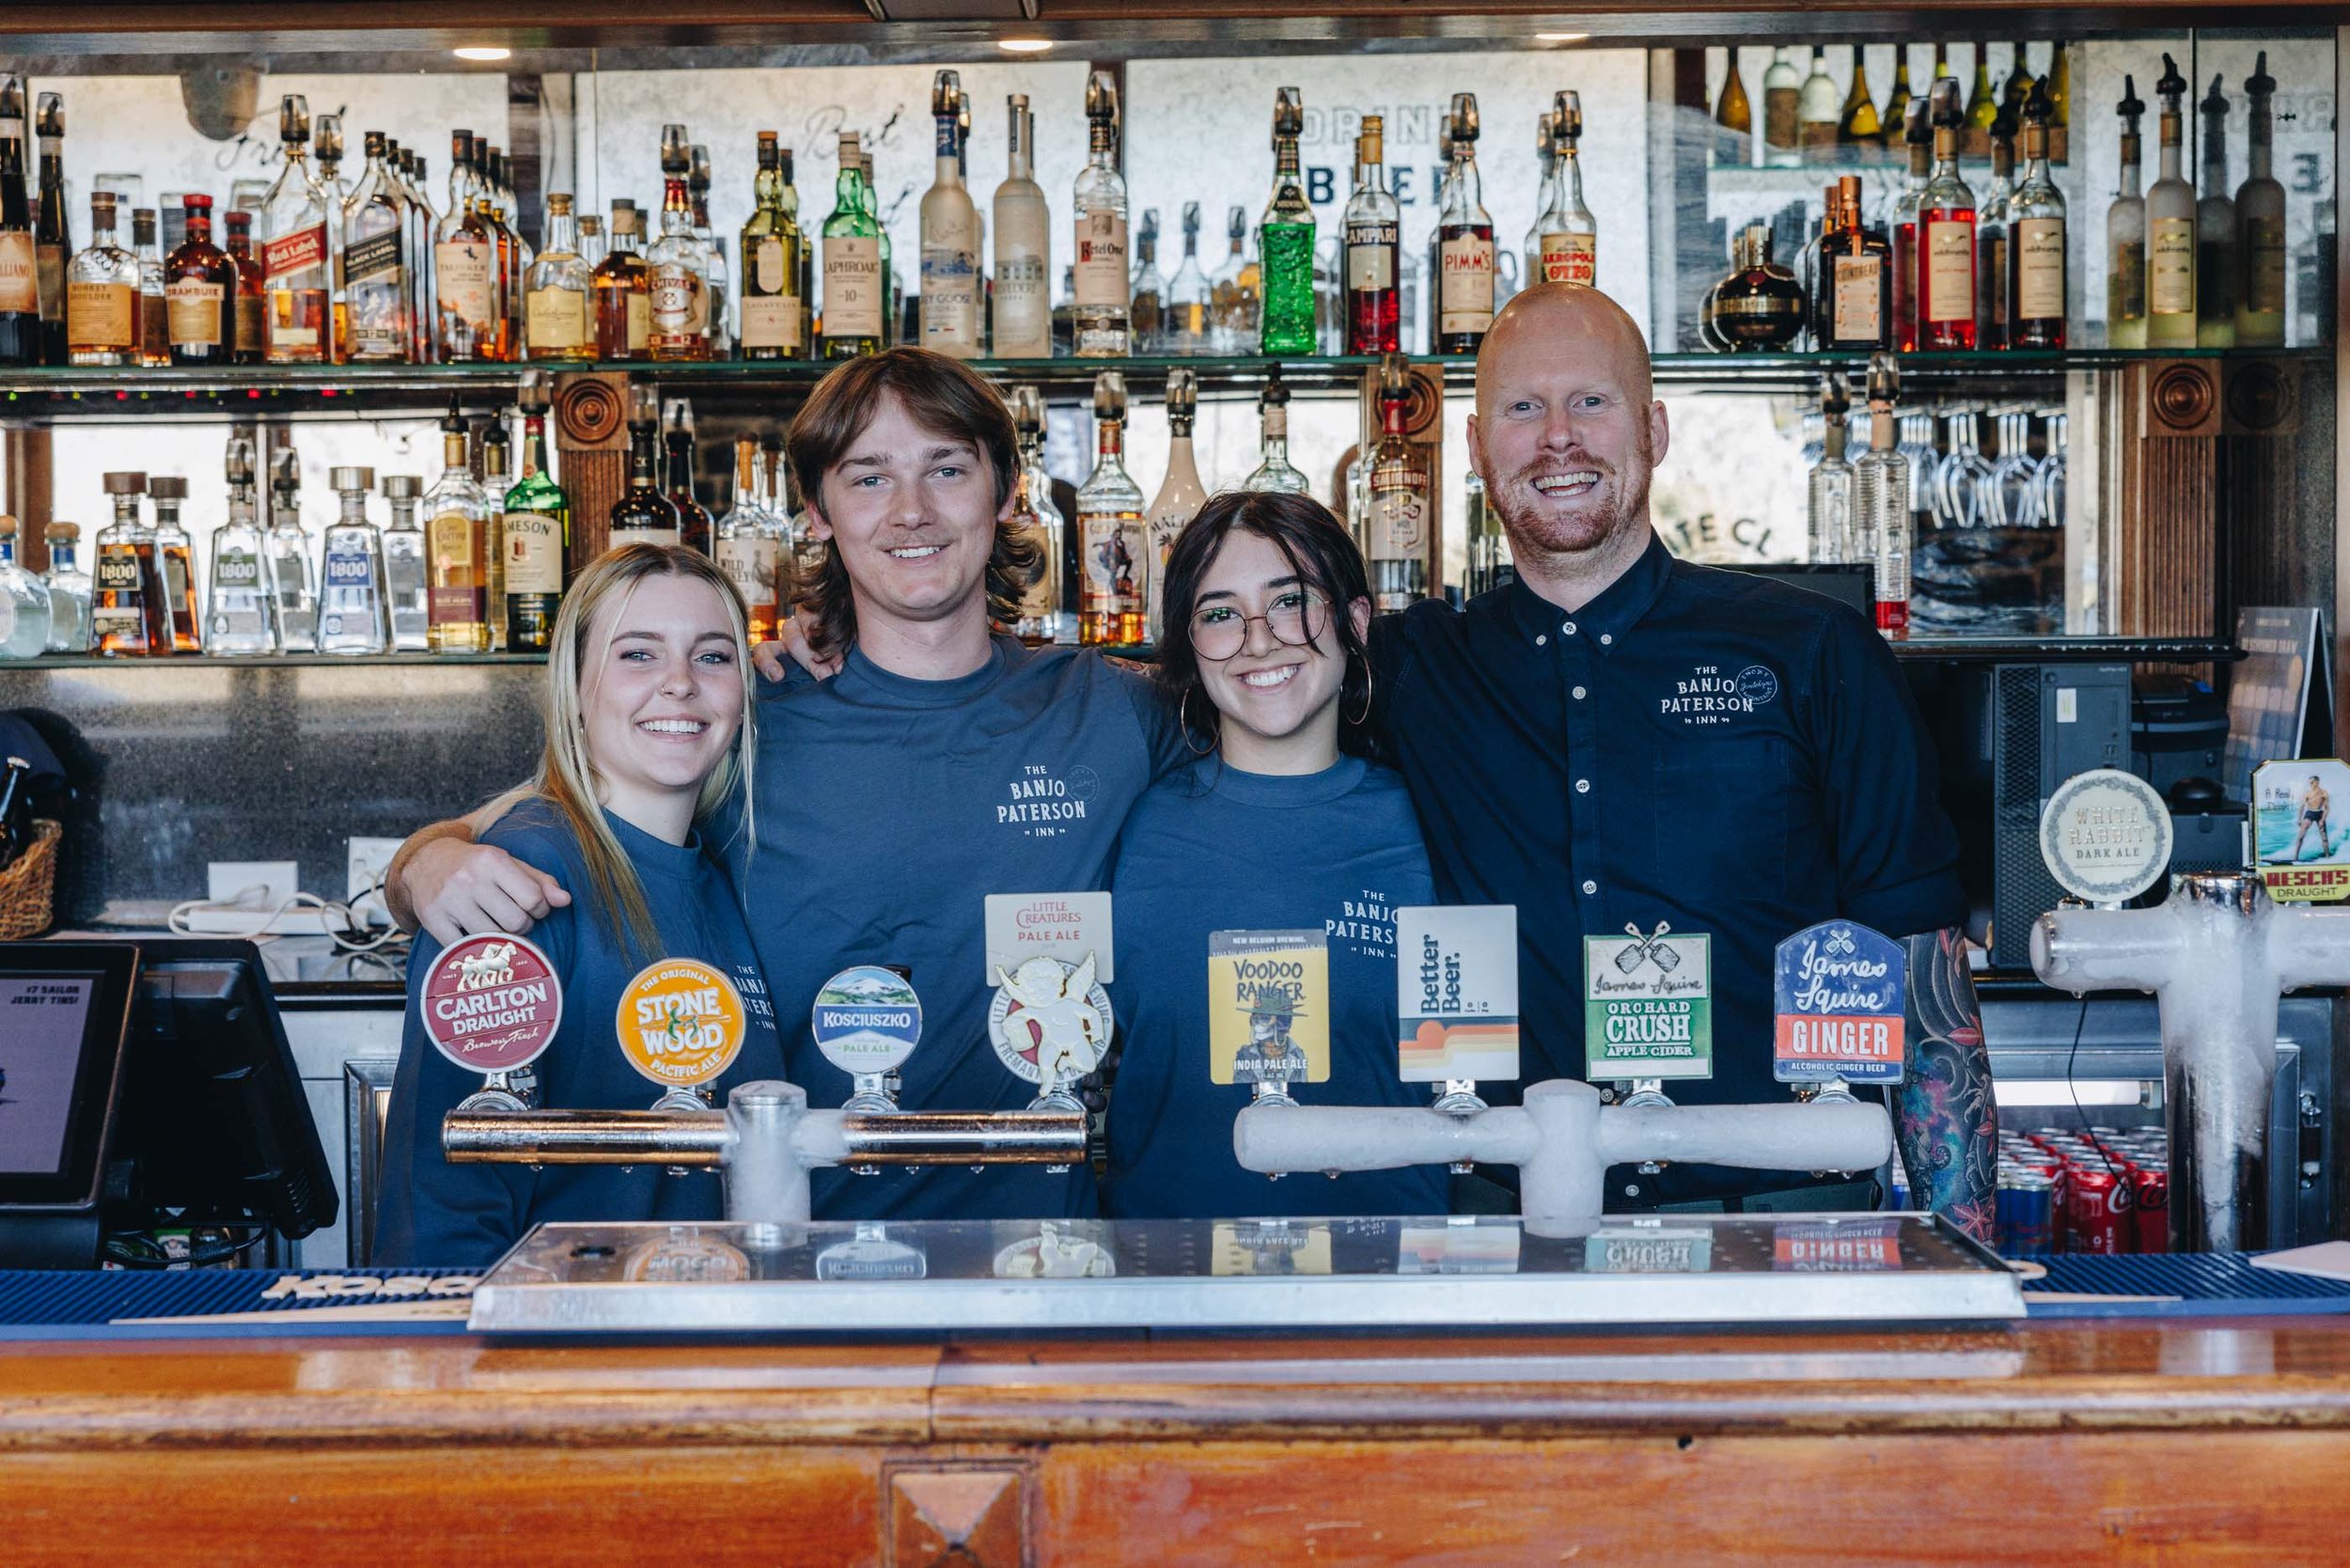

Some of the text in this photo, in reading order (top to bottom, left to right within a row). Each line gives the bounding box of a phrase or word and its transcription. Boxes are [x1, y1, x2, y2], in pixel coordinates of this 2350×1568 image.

[1444, 250, 1491, 272] PIMM'S
[651, 277, 691, 290] CHIVAS
[845, 289, 857, 303] 10
[1372, 472, 1428, 488] SMIRNOFF
[101, 564, 136, 580] 1800
[218, 562, 256, 578] 1800
[330, 561, 367, 578] 1800
[1695, 666, 1717, 675] THE
[1677, 678, 1735, 694] BANJO
[1661, 697, 1754, 713] PATERSON
[1025, 765, 1047, 775] THE
[1010, 779, 1065, 800] BANJO
[996, 801, 1086, 823] PATERSON
[2076, 807, 2138, 824] WHITE
[1035, 827, 1055, 837] INN
[2068, 825, 2143, 845] RABBIT
[2076, 847, 2140, 859] DARK ALE
[1363, 890, 1386, 902] THE
[2277, 886, 2338, 898] DRAUGHT
[1033, 902, 1067, 911] LITTLE
[1018, 930, 1080, 941] PALE ALE
[1363, 946, 1385, 958] INN
[736, 964, 756, 974] THE
[1233, 959, 1303, 980] VOODOO
[1420, 933, 1440, 1014] Better
[640, 969, 710, 992] THE ORIGINAL
[733, 976, 766, 995] BANJ
[1442, 952, 1461, 1014] Beer.
[1236, 980, 1307, 1003] RANGER
[435, 982, 548, 1021] CARLTON
[635, 987, 722, 1025] STONE
[1090, 984, 1111, 1025] EWING
[1607, 1001, 1691, 1014] ORCHARD
[452, 1007, 537, 1036] DRAUGHT
[822, 1012, 911, 1028] KOSCIUSZKO
[1606, 1014, 1691, 1043] CRUSH
[641, 1023, 723, 1055] WOOD
[1792, 1020, 1889, 1056] GINGER
[997, 1041, 1041, 1079] FREMANT
[1606, 1046, 1694, 1058] APPLE CIDER
[650, 1051, 722, 1076] PACIFIC ALE
[1233, 1058, 1308, 1071] INDIA PALE ALE
[1791, 1061, 1887, 1073] ALCOHOLIC GINGER BEER
